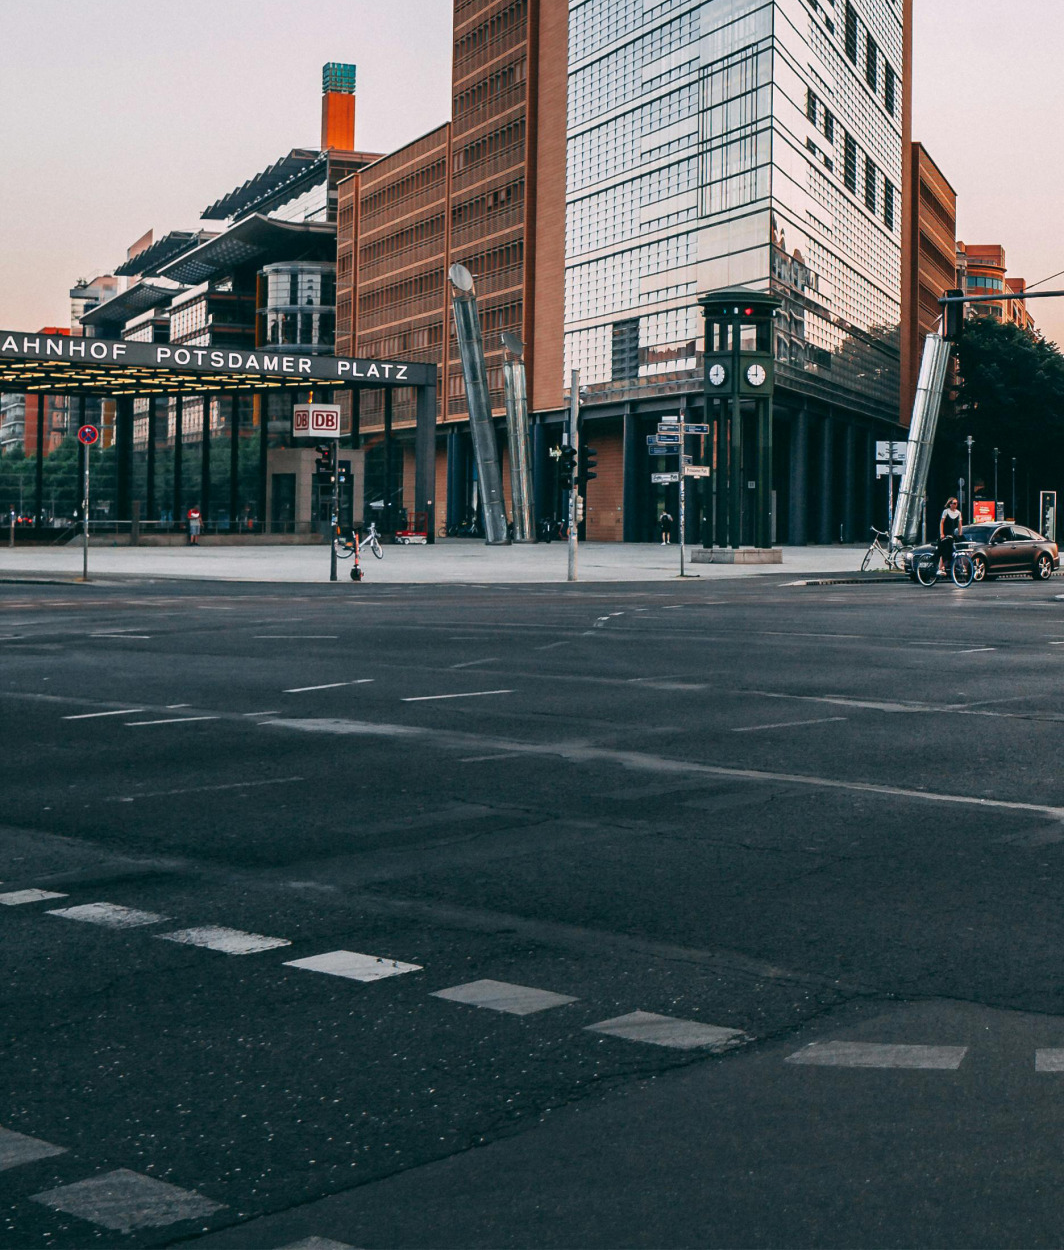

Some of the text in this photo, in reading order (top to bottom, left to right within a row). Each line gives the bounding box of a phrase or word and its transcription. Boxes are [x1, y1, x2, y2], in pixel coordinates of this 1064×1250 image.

[155, 347, 313, 375] POTSDAMER
[337, 360, 408, 381] PLATZ
[296, 413, 308, 427] DB
[315, 413, 335, 427] DB
